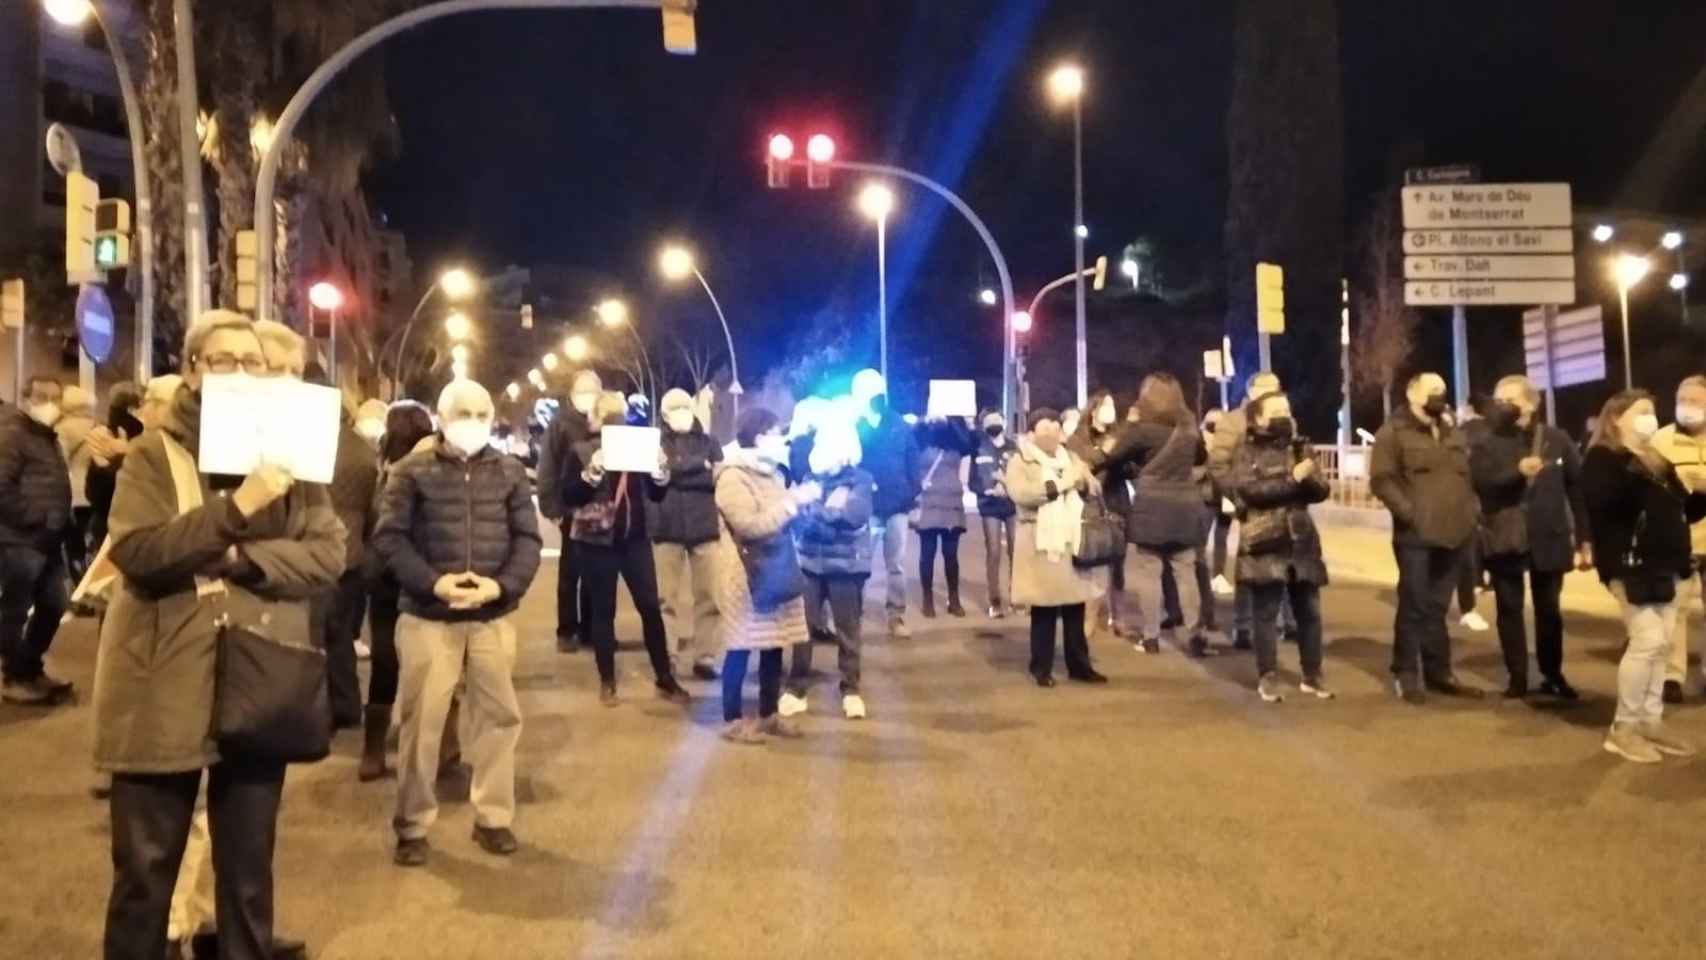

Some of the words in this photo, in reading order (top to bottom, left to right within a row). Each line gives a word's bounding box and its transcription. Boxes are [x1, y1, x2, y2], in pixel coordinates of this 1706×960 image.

[1428, 209, 1445, 221] de
[1449, 207, 1525, 221] Montserrat
[1450, 232, 1493, 246] Alfons
[1496, 233, 1509, 246] el
[1465, 258, 1491, 272] Dalt
[1449, 284, 1497, 299] Lepant
